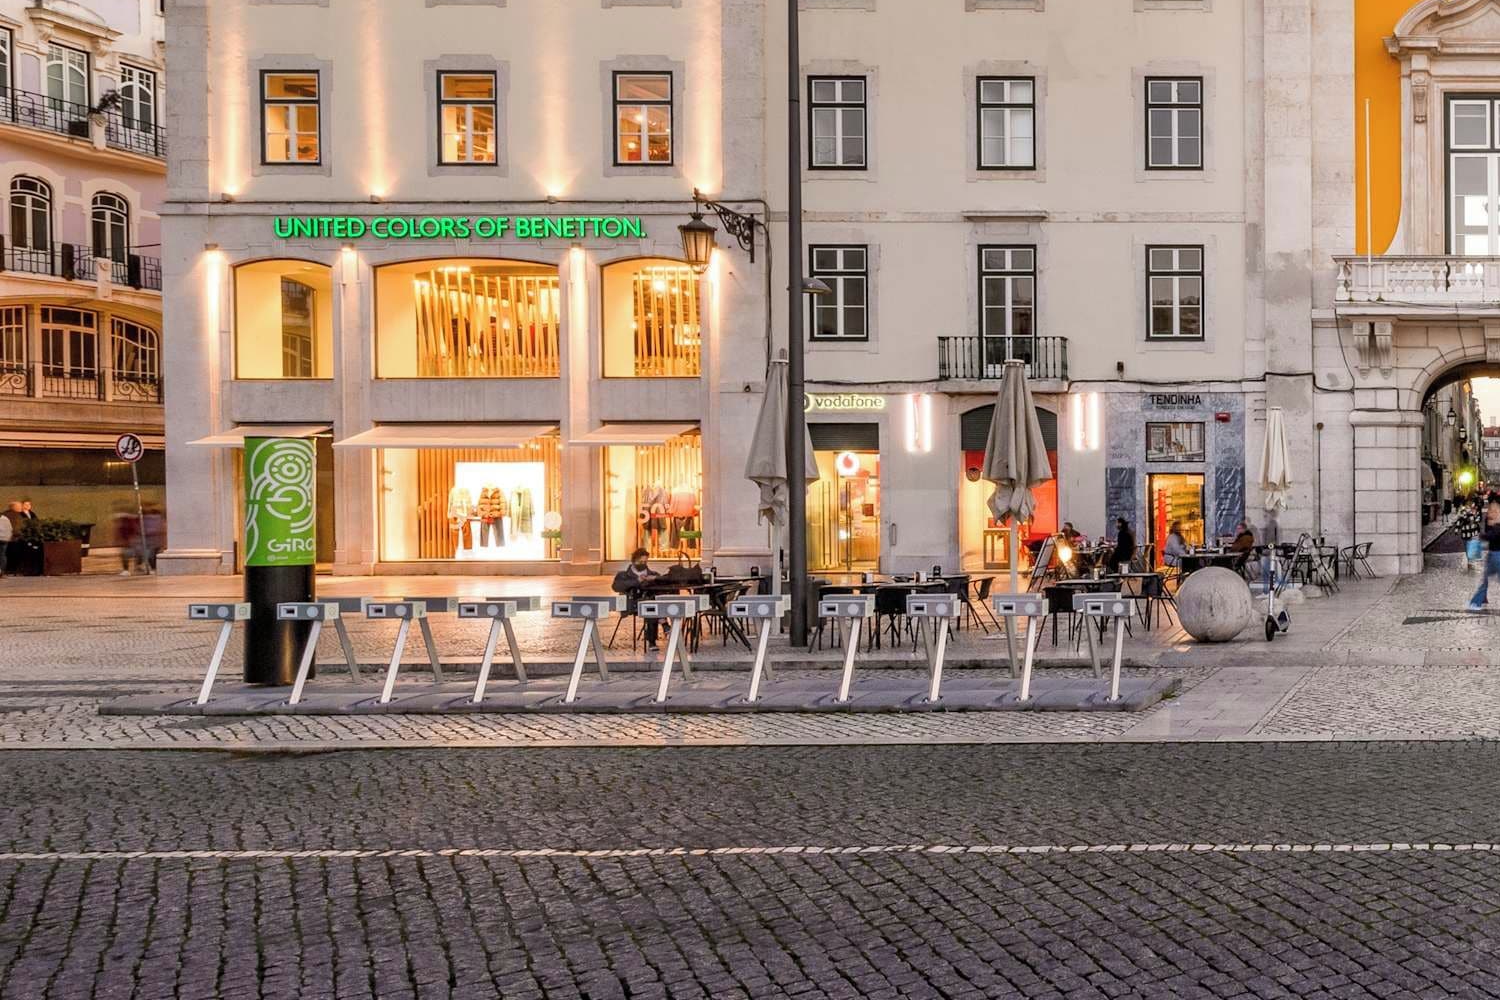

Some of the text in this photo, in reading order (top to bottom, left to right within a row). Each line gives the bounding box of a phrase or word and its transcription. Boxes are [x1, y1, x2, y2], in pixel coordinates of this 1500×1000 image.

[274, 216, 366, 238] UNITED
[371, 216, 471, 238] COLORS
[475, 216, 509, 238] OF
[815, 395, 883, 408] vodafone
[1151, 394, 1201, 405] TENDINHA
